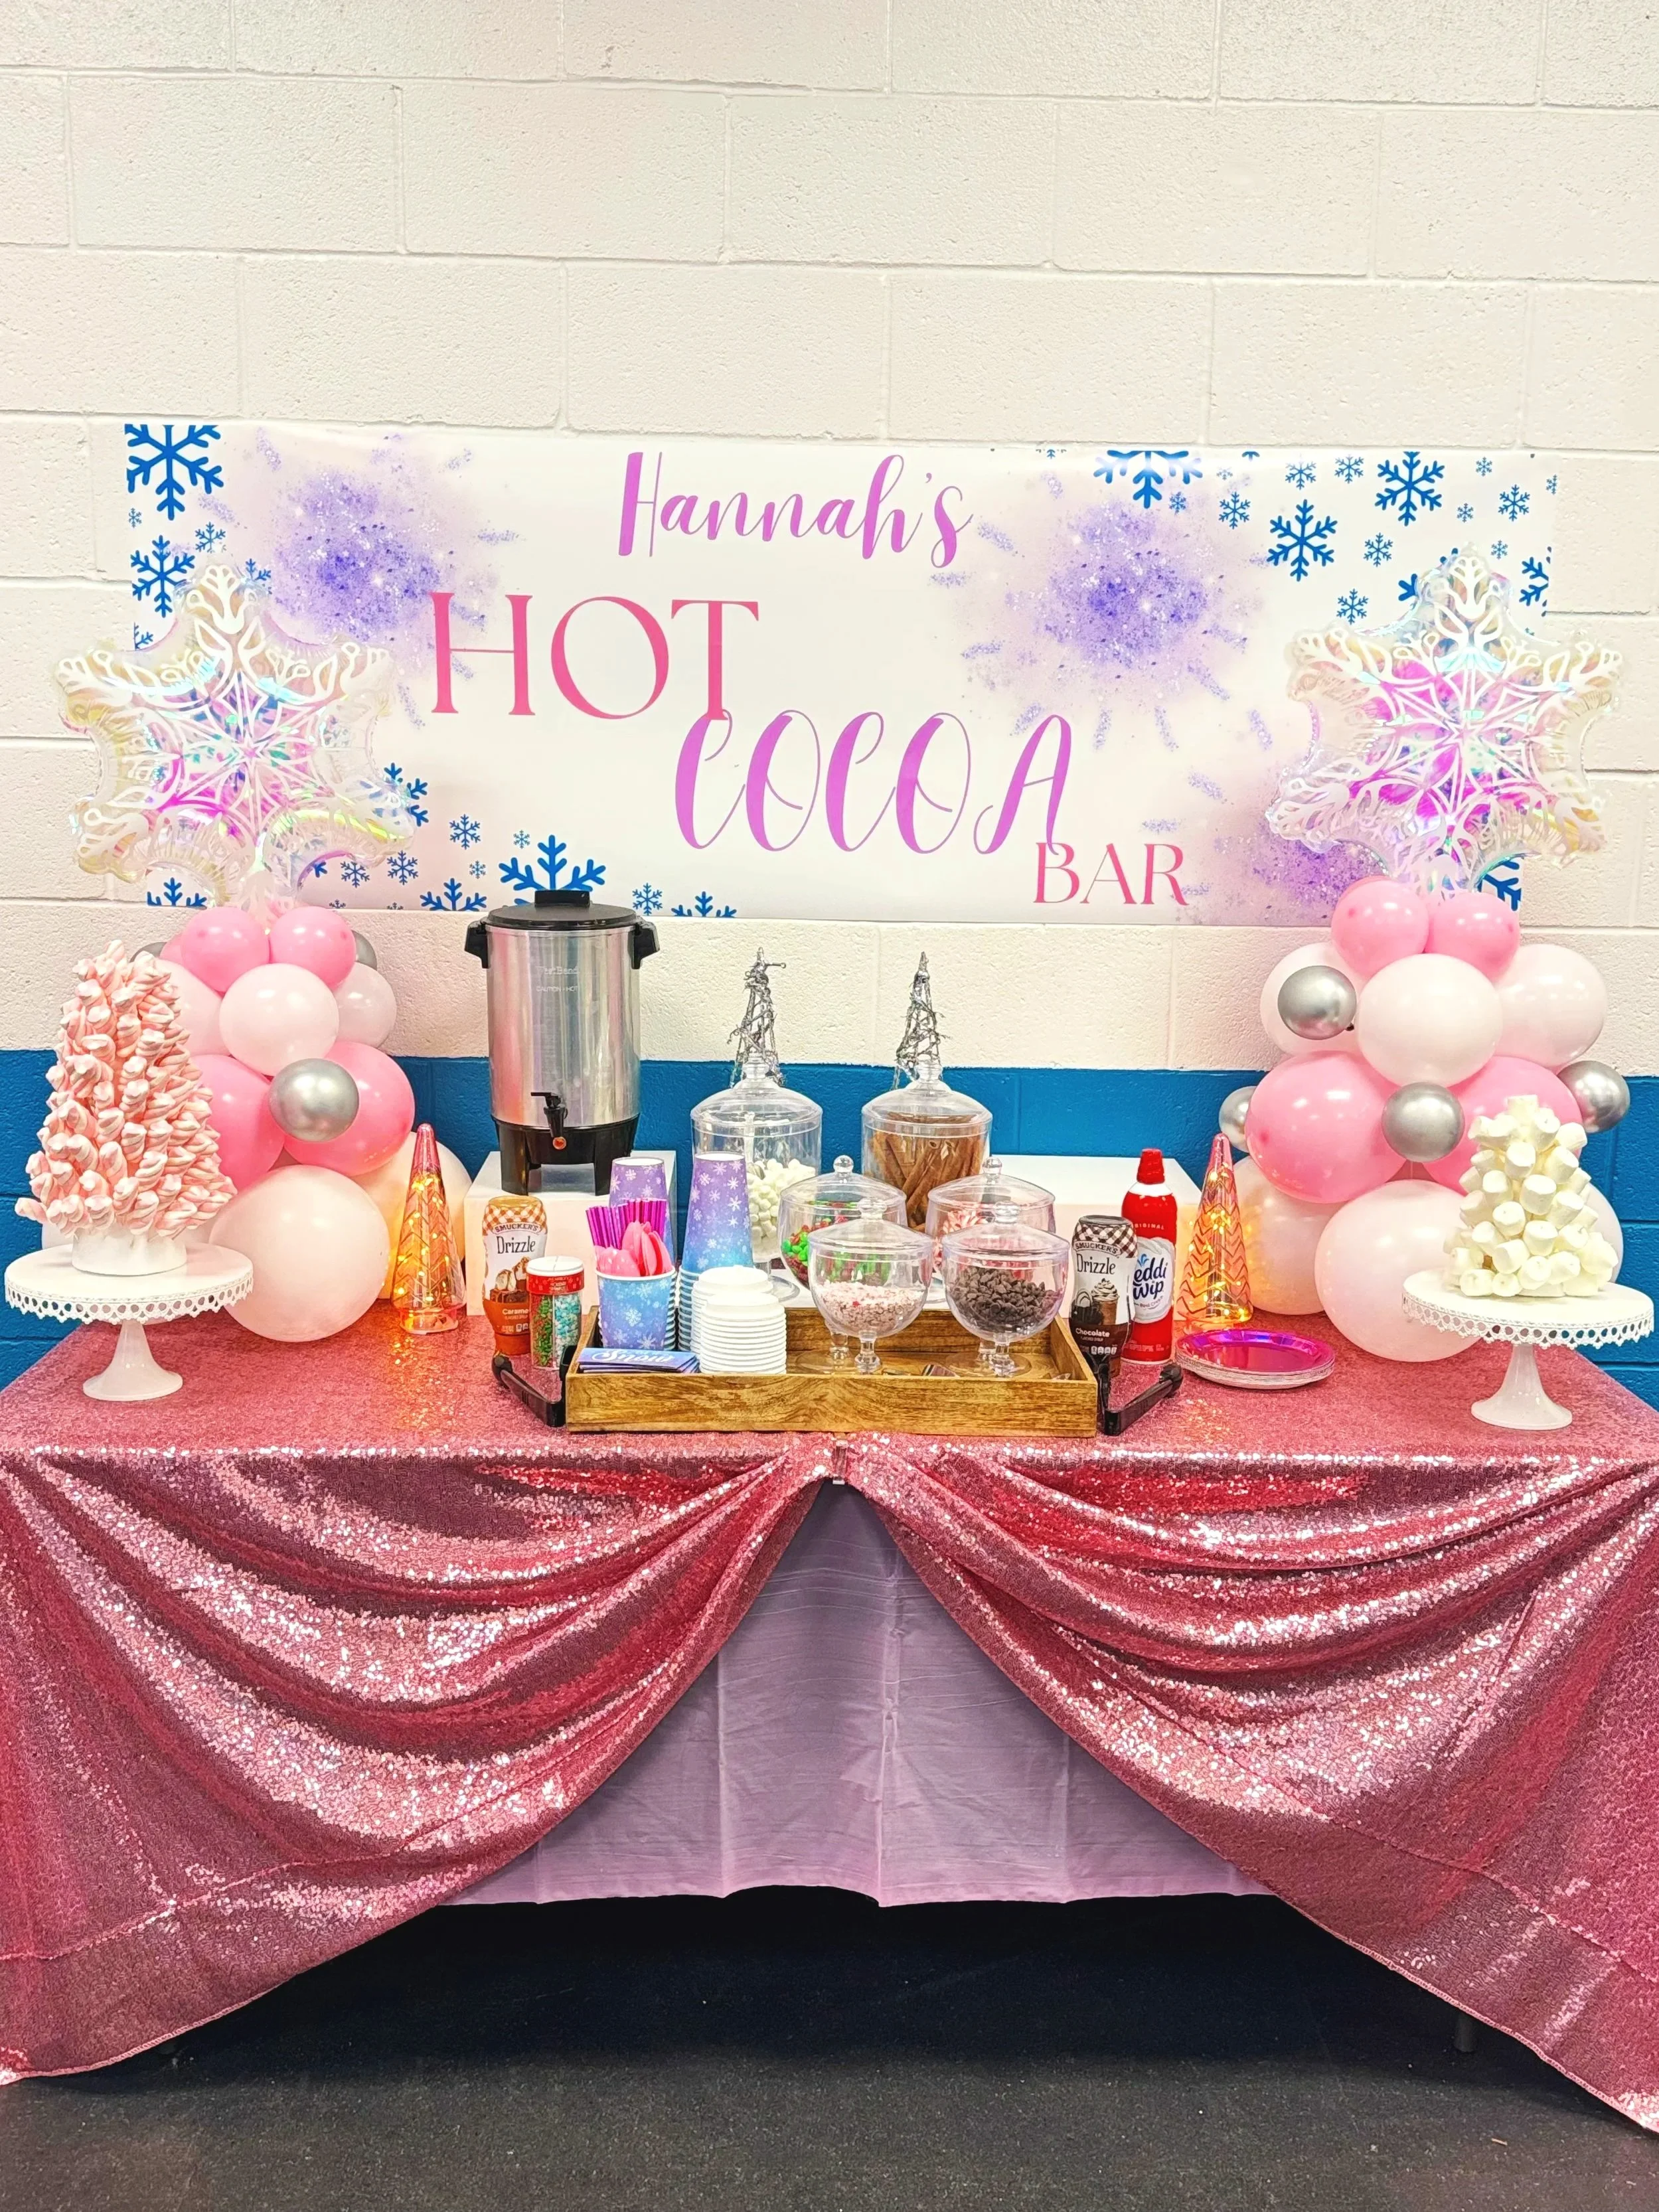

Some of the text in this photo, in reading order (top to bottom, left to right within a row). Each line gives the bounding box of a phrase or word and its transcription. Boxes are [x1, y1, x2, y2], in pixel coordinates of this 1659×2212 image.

[618, 451, 974, 568] Hannah's
[428, 592, 759, 721] HOT
[674, 708, 1071, 855] COCOA
[1033, 842, 1190, 906] BAR
[495, 1223, 539, 1233] SMUCKER'S
[497, 1235, 536, 1254] Drizzle
[1075, 1243, 1119, 1255] SMUCKER'S
[1077, 1253, 1116, 1275] Drizzle
[1133, 1257, 1168, 1283] eddi
[1075, 1327, 1110, 1338] Chocolate
[592, 1349, 675, 1362] Snow
